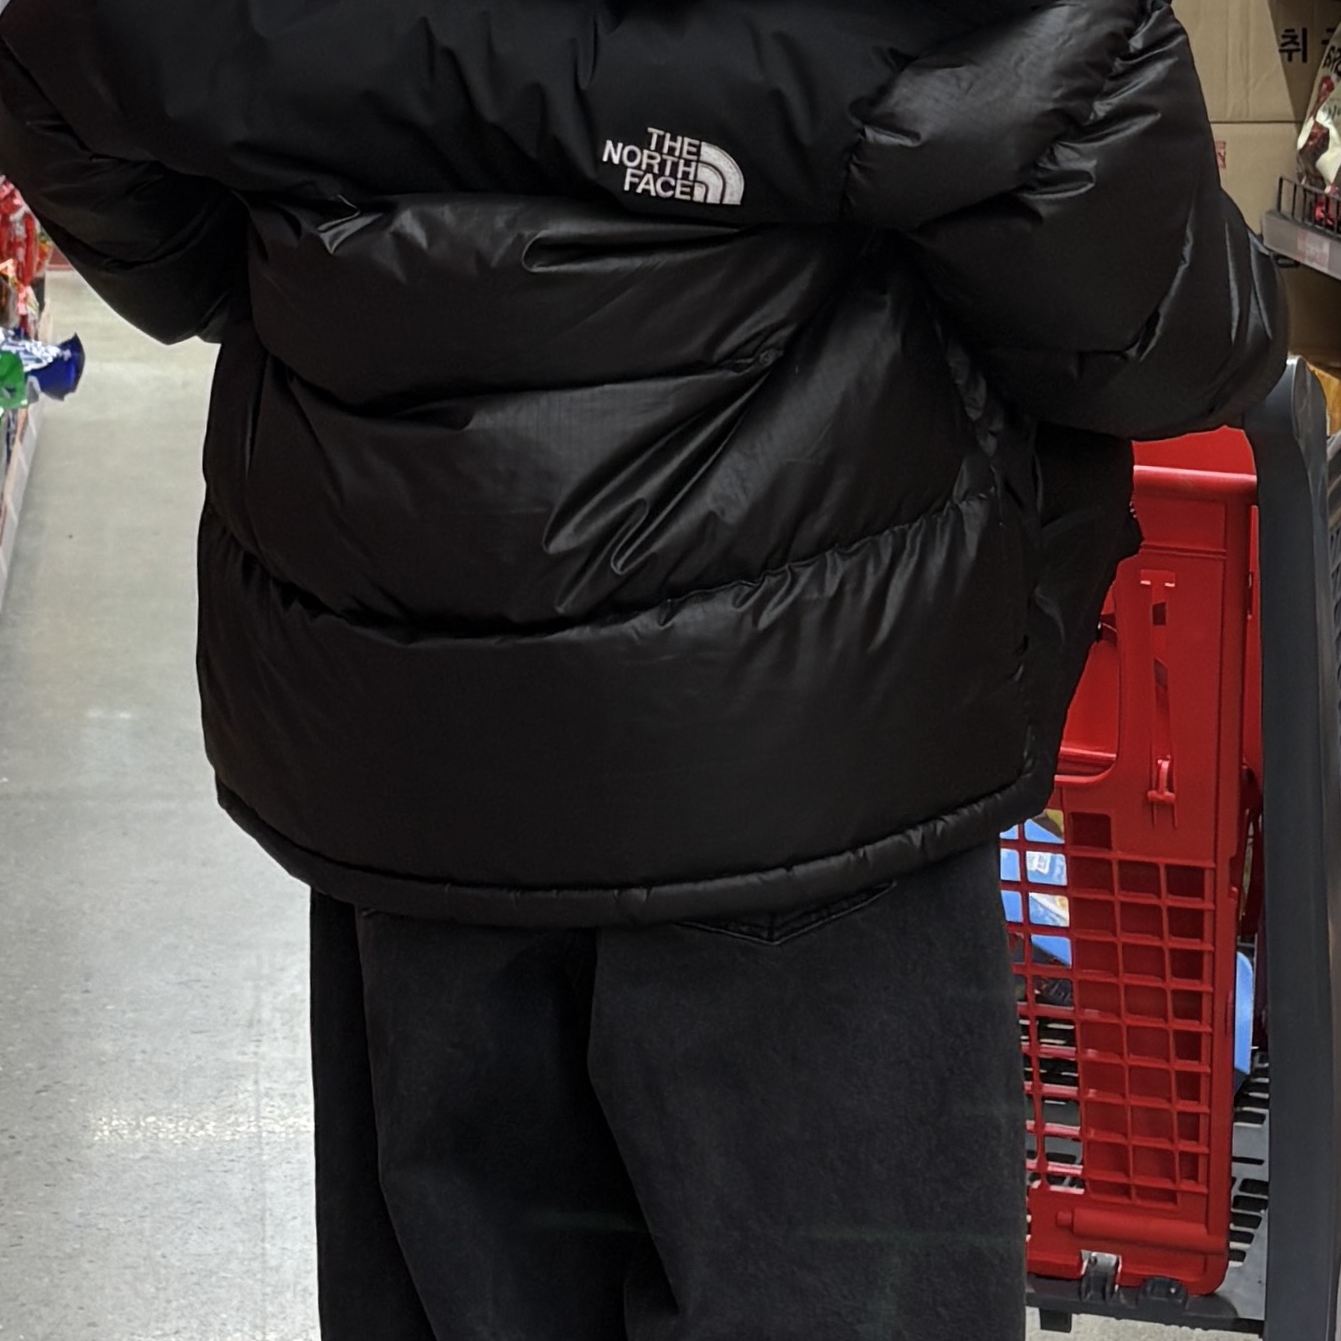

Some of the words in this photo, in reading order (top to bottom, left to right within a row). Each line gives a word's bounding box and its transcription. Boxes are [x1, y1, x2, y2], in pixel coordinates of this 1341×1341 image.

[647, 127, 700, 159] THE
[602, 140, 698, 182] NORTH
[624, 168, 695, 202] FACE
